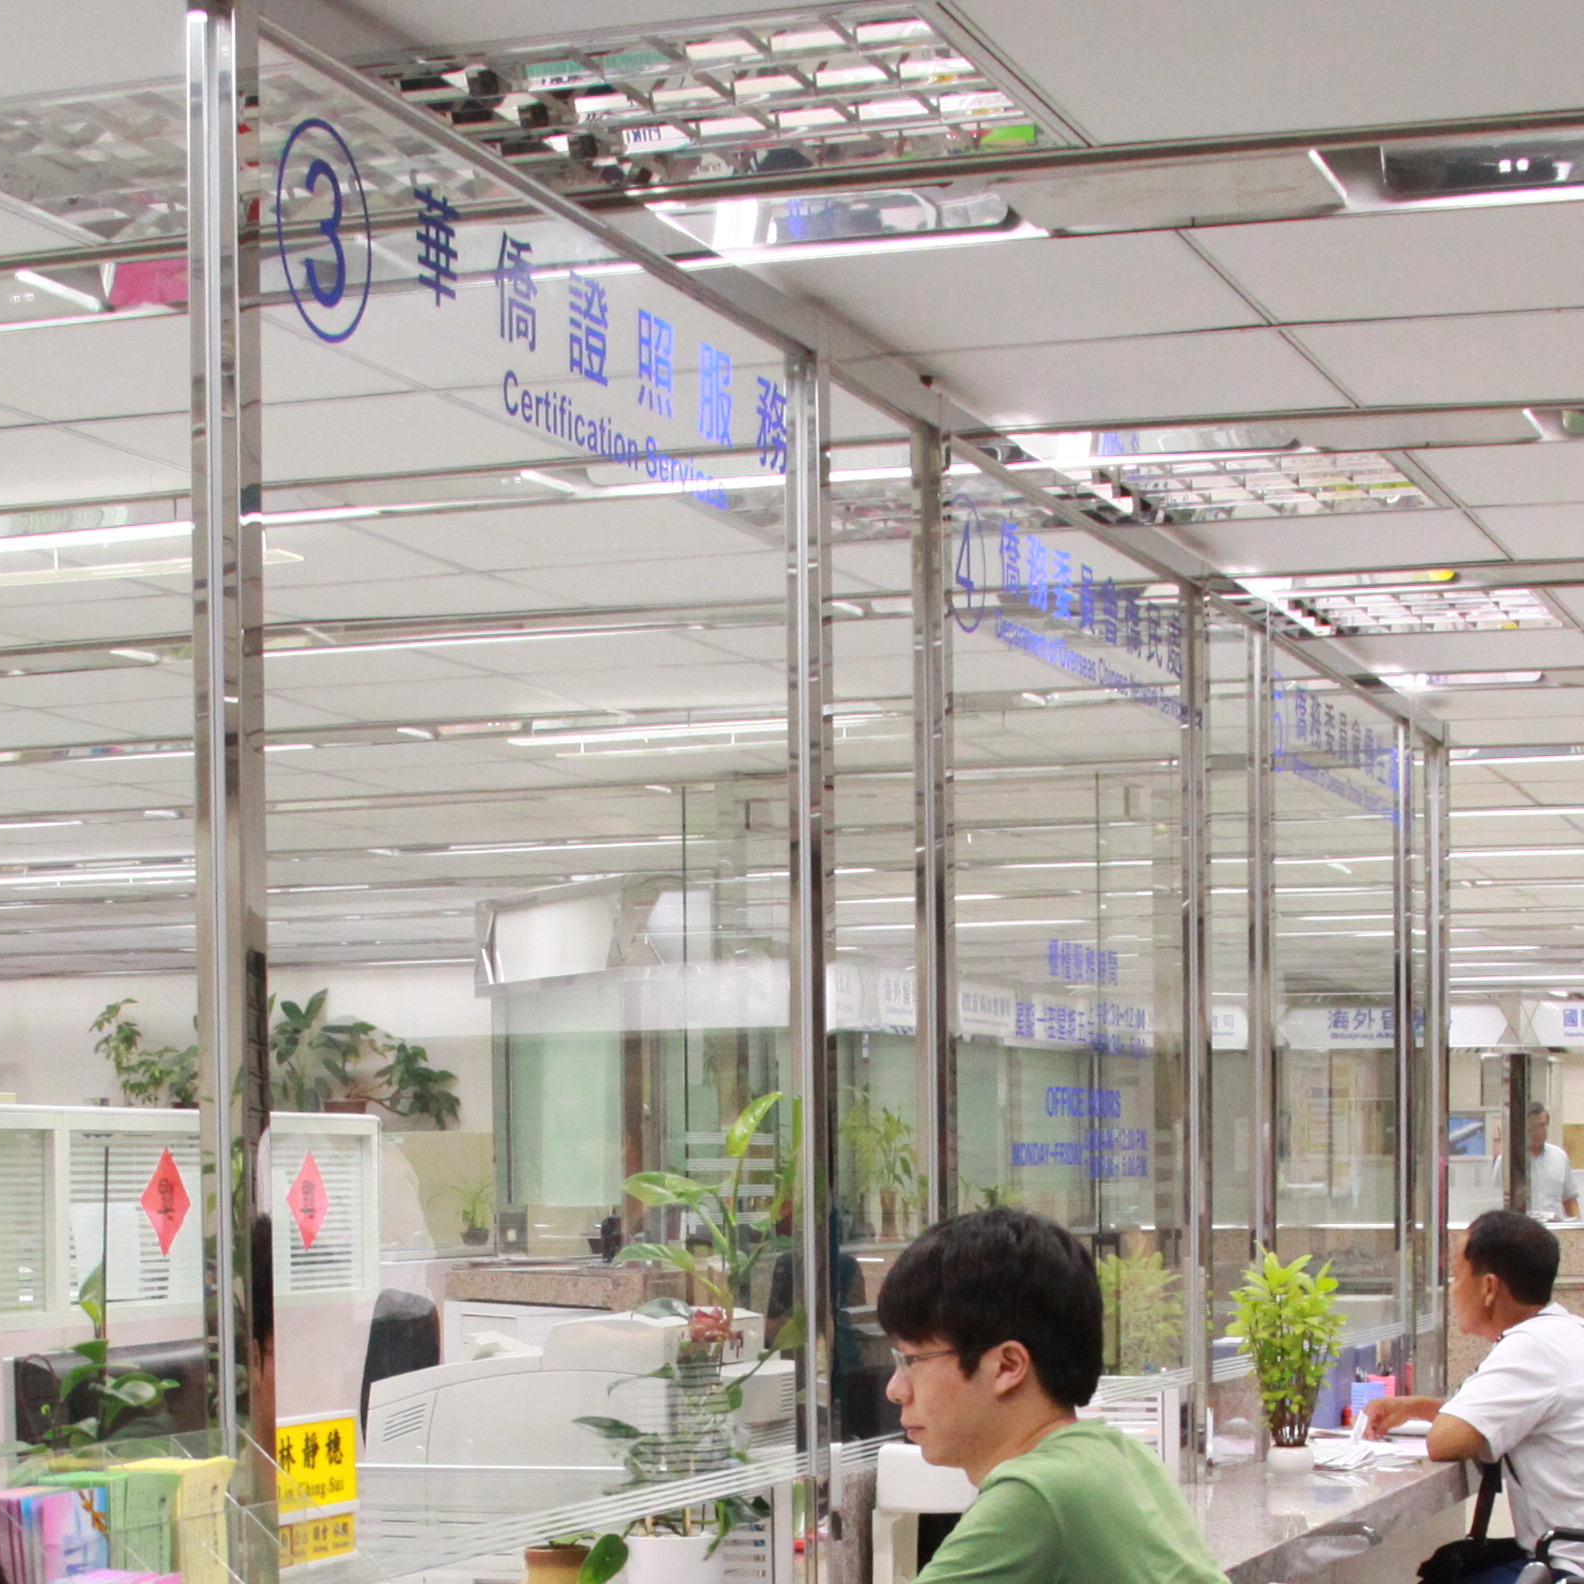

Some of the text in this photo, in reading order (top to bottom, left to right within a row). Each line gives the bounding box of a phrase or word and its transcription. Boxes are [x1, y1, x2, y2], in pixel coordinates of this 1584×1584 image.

[413, 187, 788, 475] 華僑證照服務
[502, 369, 728, 510] Certification Services
[1046, 1086, 1084, 1118] OFFICE
[278, 1428, 344, 1474] 林靜穗
